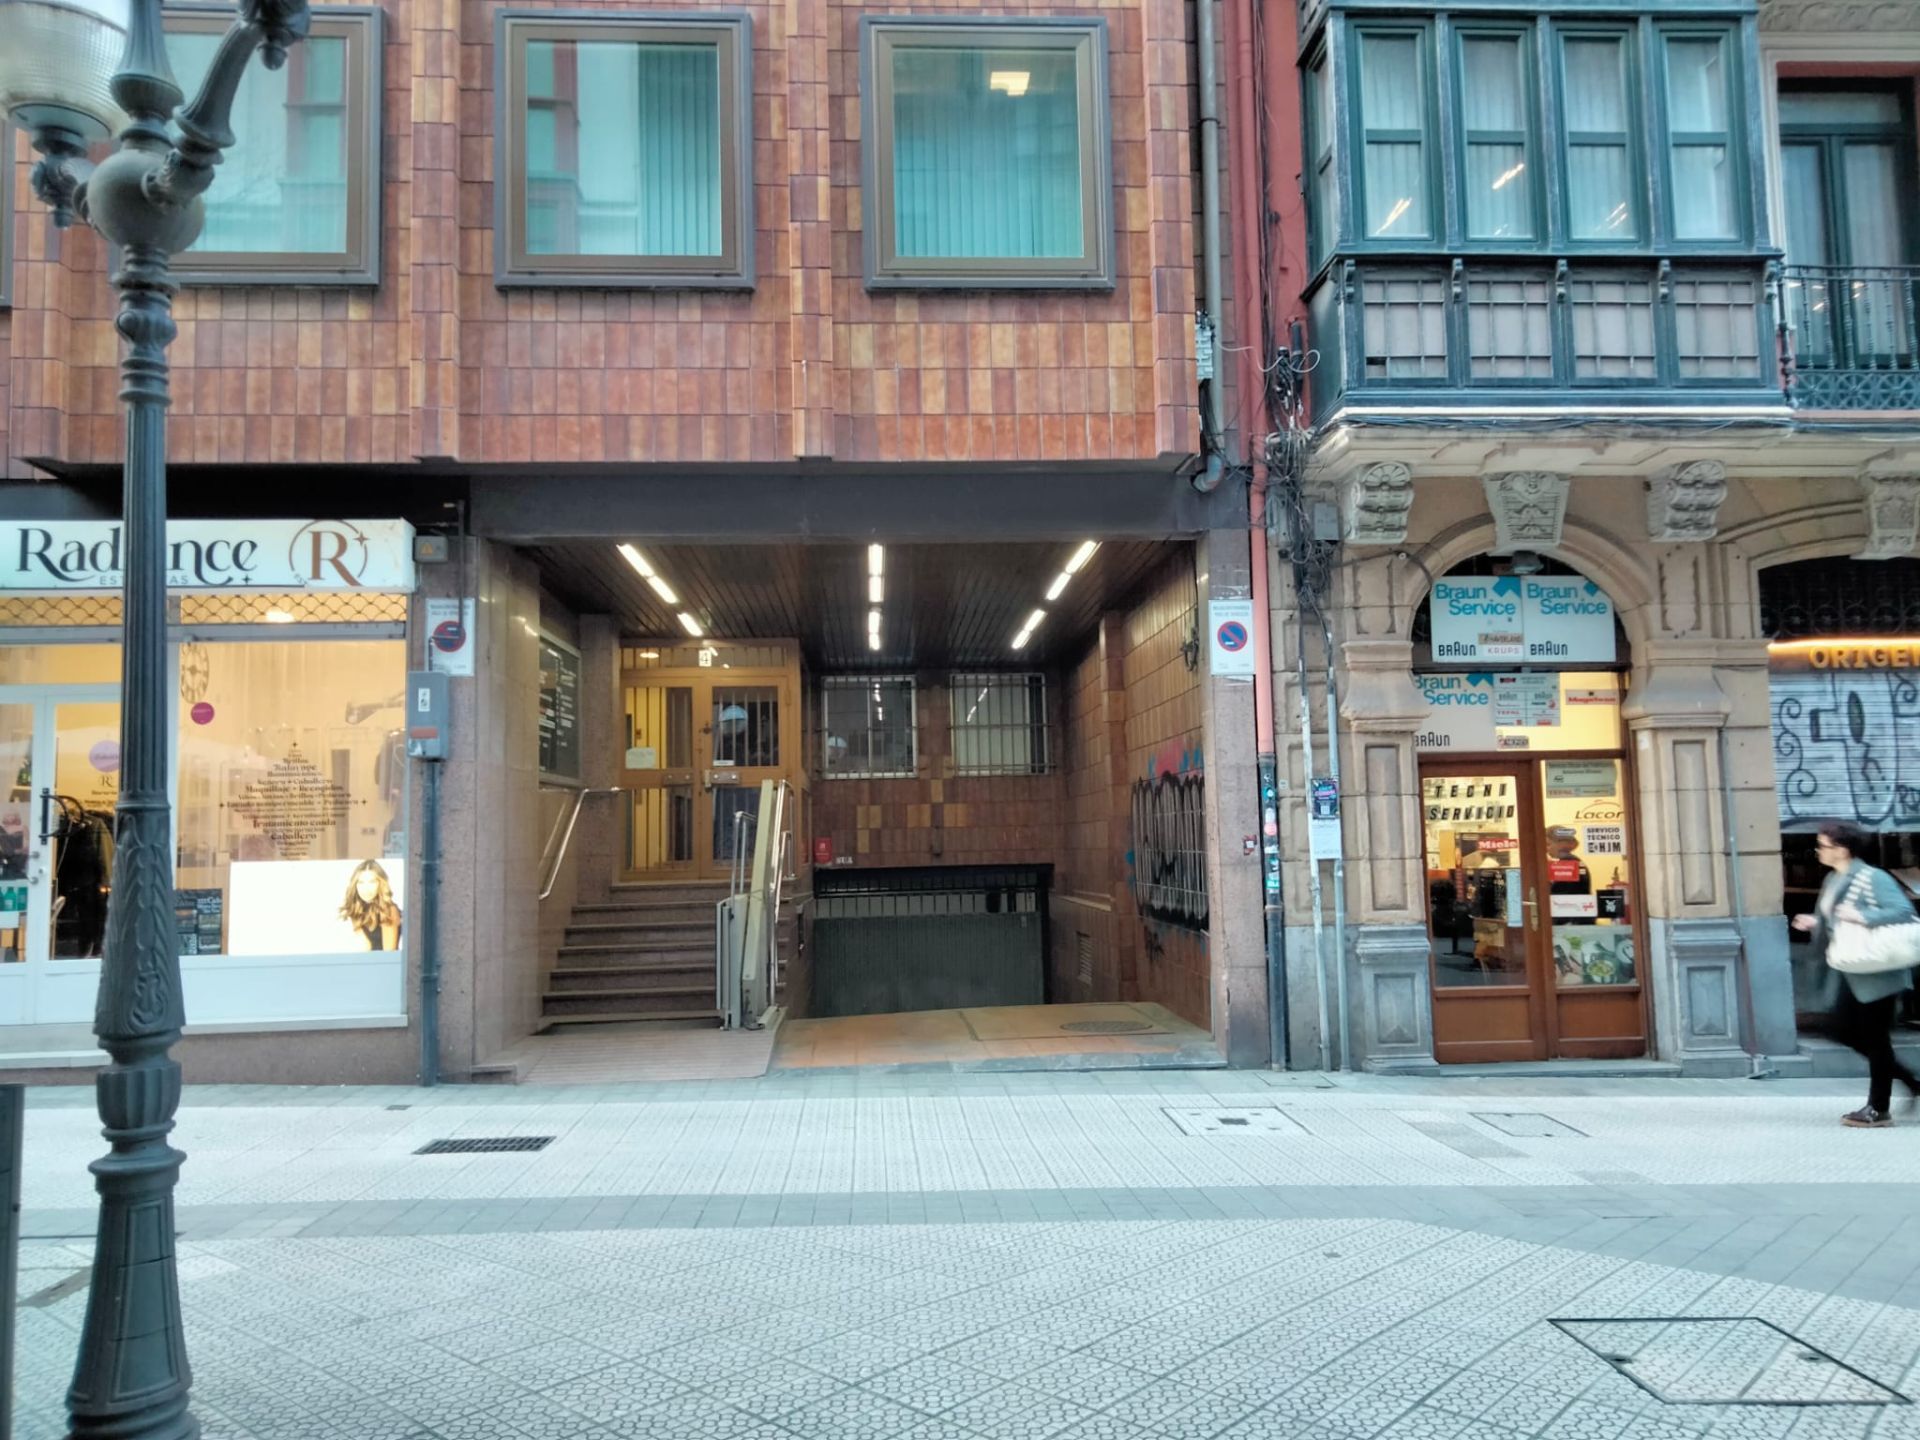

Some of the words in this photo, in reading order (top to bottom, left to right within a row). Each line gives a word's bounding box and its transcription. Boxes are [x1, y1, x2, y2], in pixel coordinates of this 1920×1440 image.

[16, 526, 258, 586] Radnce
[308, 531, 362, 586] R
[1435, 583, 1487, 599] Braun
[1527, 583, 1578, 599] Braun
[1449, 599, 1516, 615] Service
[1541, 599, 1607, 615] Service
[1487, 646, 1520, 654] KRUPS
[1423, 689, 1489, 705] Service
[1435, 783, 1507, 798] TECNI
[1429, 805, 1515, 820] SERVICIO
[1575, 810, 1624, 820] Lacor
[1478, 840, 1518, 849] Miele
